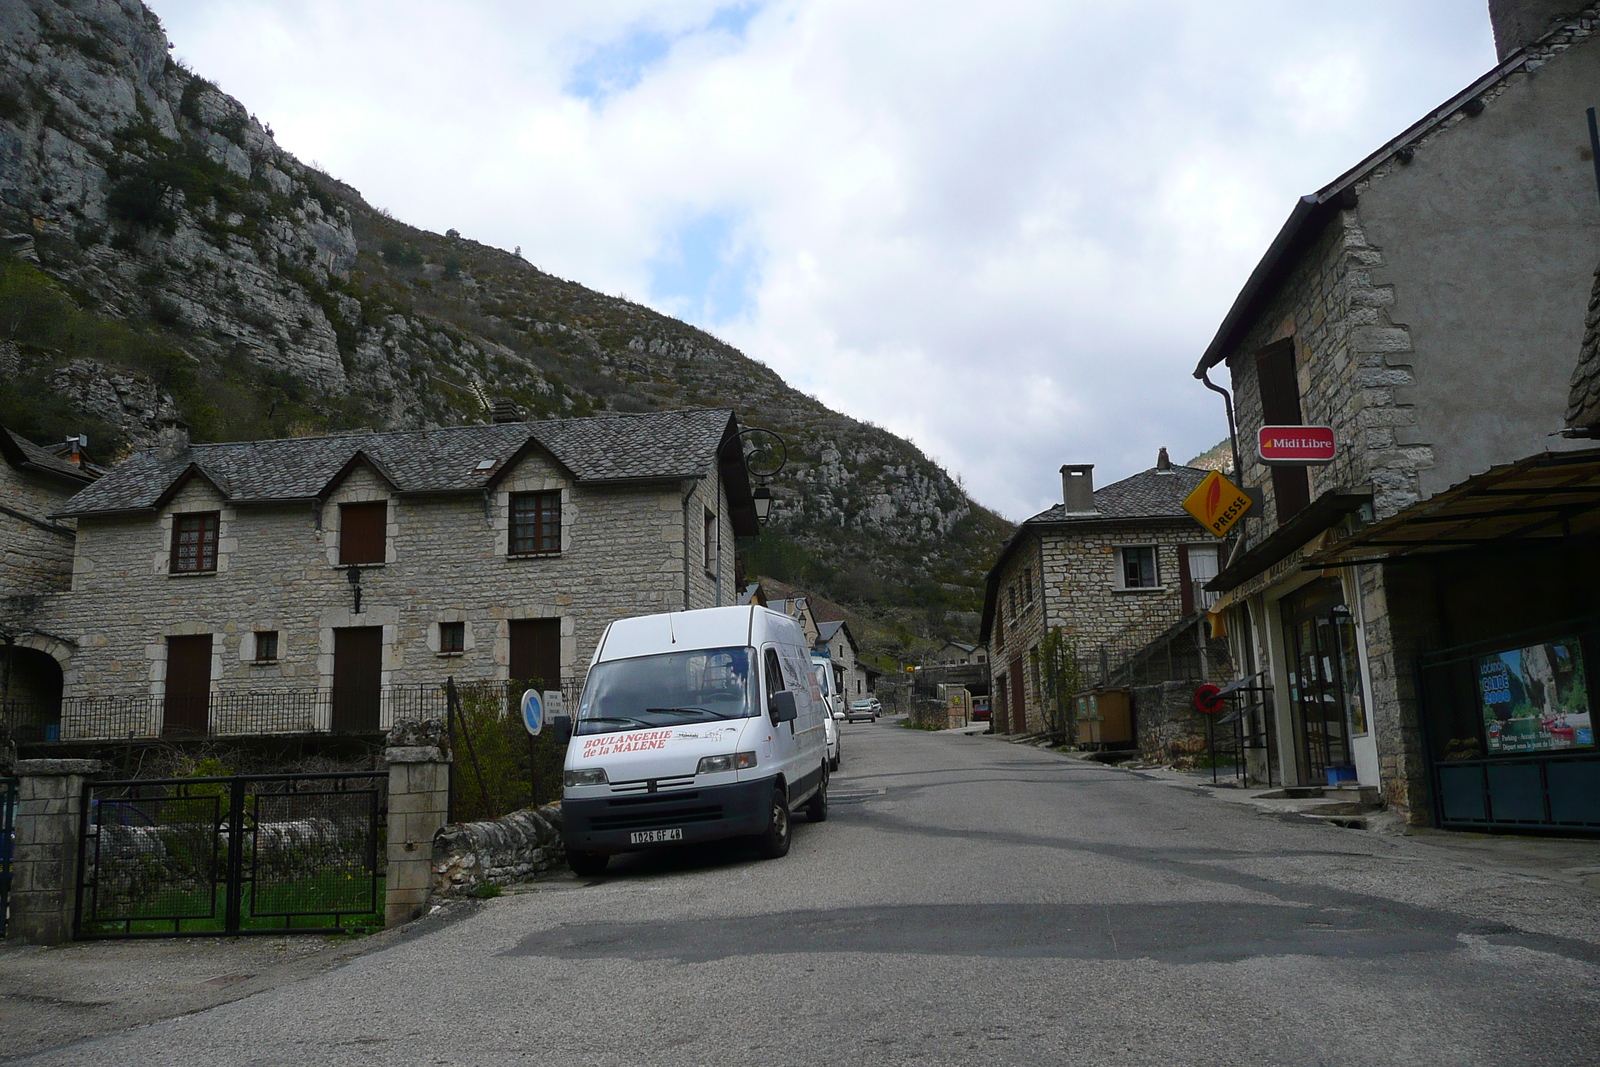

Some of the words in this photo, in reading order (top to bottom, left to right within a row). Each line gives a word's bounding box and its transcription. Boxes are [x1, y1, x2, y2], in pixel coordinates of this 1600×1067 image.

[1273, 438, 1299, 448] Midi
[1302, 438, 1332, 448] Libre
[1213, 496, 1247, 532] PRESSE
[1232, 587, 1240, 601] LE
[1484, 689, 1511, 705] 2000
[583, 730, 673, 749] BOULANGERIE
[1502, 734, 1517, 742] Parking
[583, 749, 596, 758] de
[598, 746, 609, 756] la
[612, 739, 667, 753] MALENE
[633, 831, 654, 843] 1026
[656, 830, 667, 841] GF
[670, 828, 680, 839] 48
